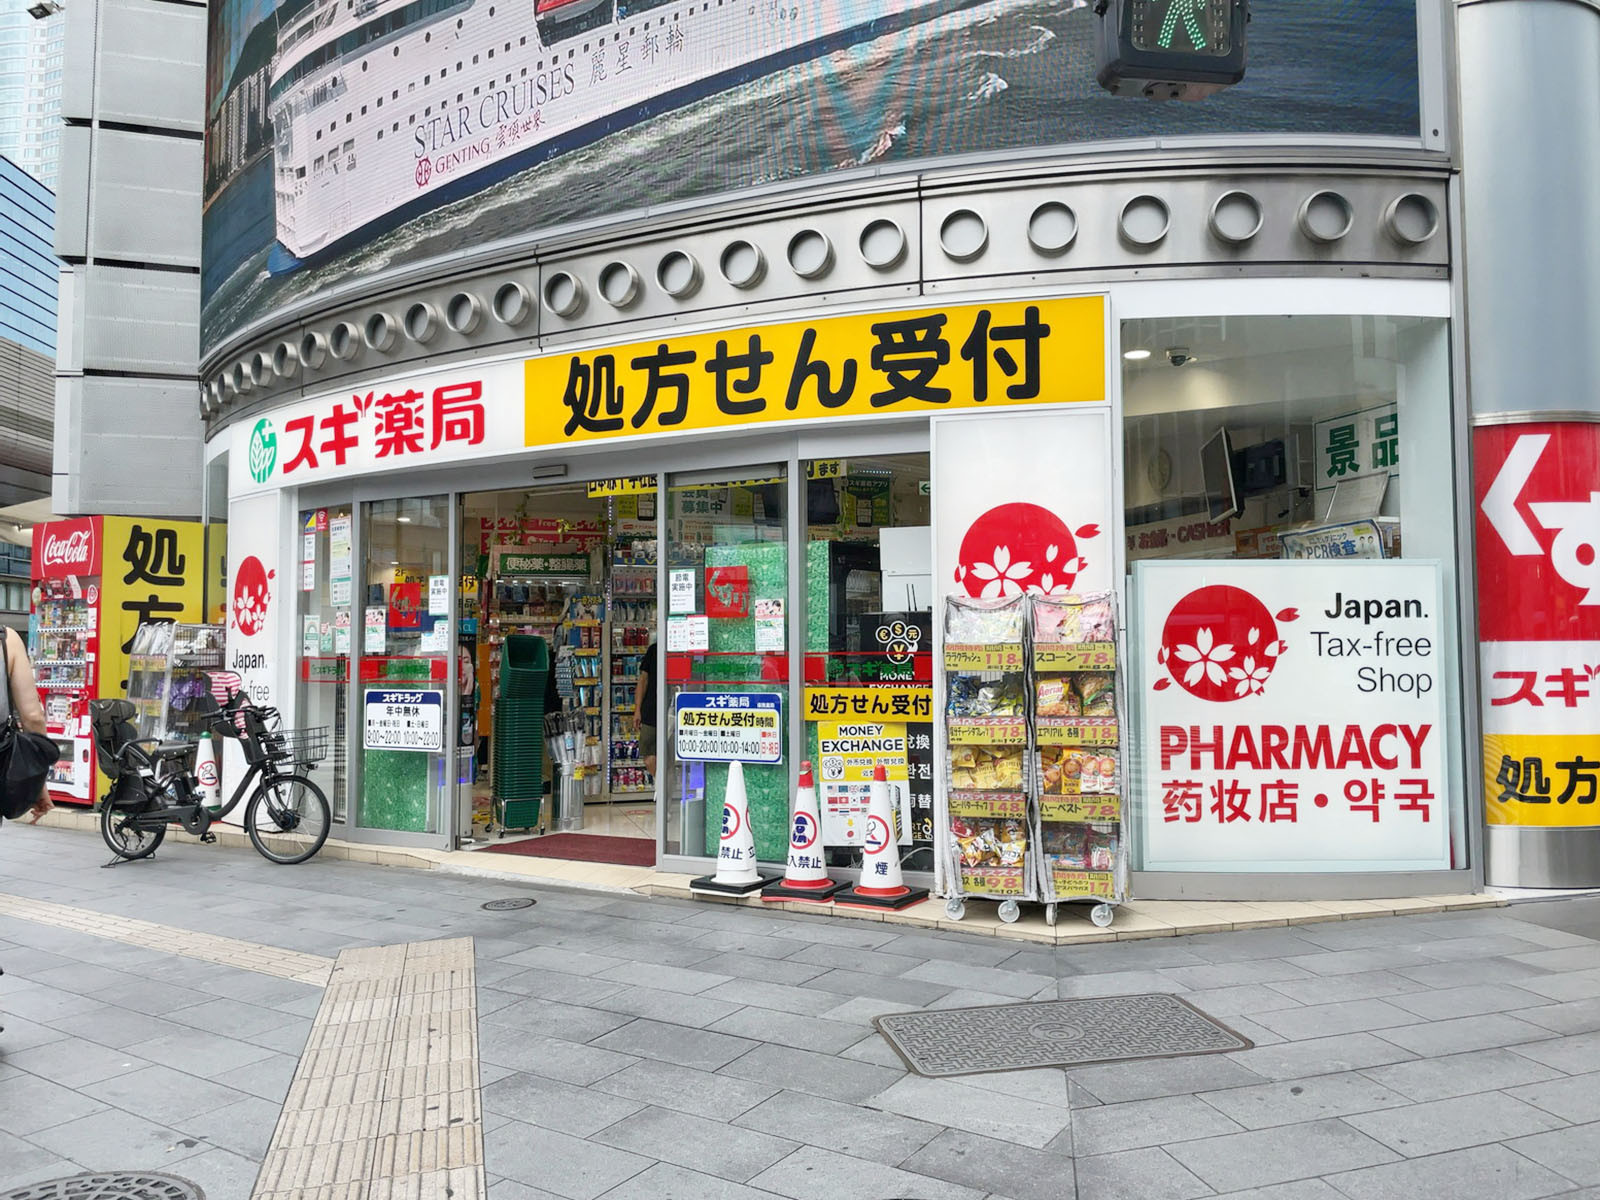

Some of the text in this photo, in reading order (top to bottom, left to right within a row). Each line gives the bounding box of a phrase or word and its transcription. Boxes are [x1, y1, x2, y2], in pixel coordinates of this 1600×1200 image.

[414, 62, 576, 158] STAR CRUISES
[435, 137, 490, 174] GENTING
[563, 305, 1051, 437] 処方せん受付
[282, 380, 486, 475] スギ薬局
[44, 529, 91, 566] Coca-Cola
[1324, 593, 1429, 625] Japan.
[1310, 631, 1433, 658] Tax-free
[232, 648, 268, 674] Japan.
[1036, 652, 1077, 662] スコーン
[880, 672, 916, 681] MONE
[1356, 667, 1433, 699] Shop
[382, 693, 424, 703] スギドラッグ
[705, 694, 750, 708] スギ薬局
[810, 693, 932, 716] 処方せん受付
[386, 706, 420, 717] 年中無休
[1039, 718, 1117, 726] 当店オススメ
[839, 725, 883, 736] MONEY
[821, 739, 904, 753] EXCHANGE
[1160, 724, 1433, 771] PHARMACY
[1496, 754, 1600, 805] 処方
[1040, 802, 1082, 813] ハーベスト
[786, 855, 822, 870] 入禁止
